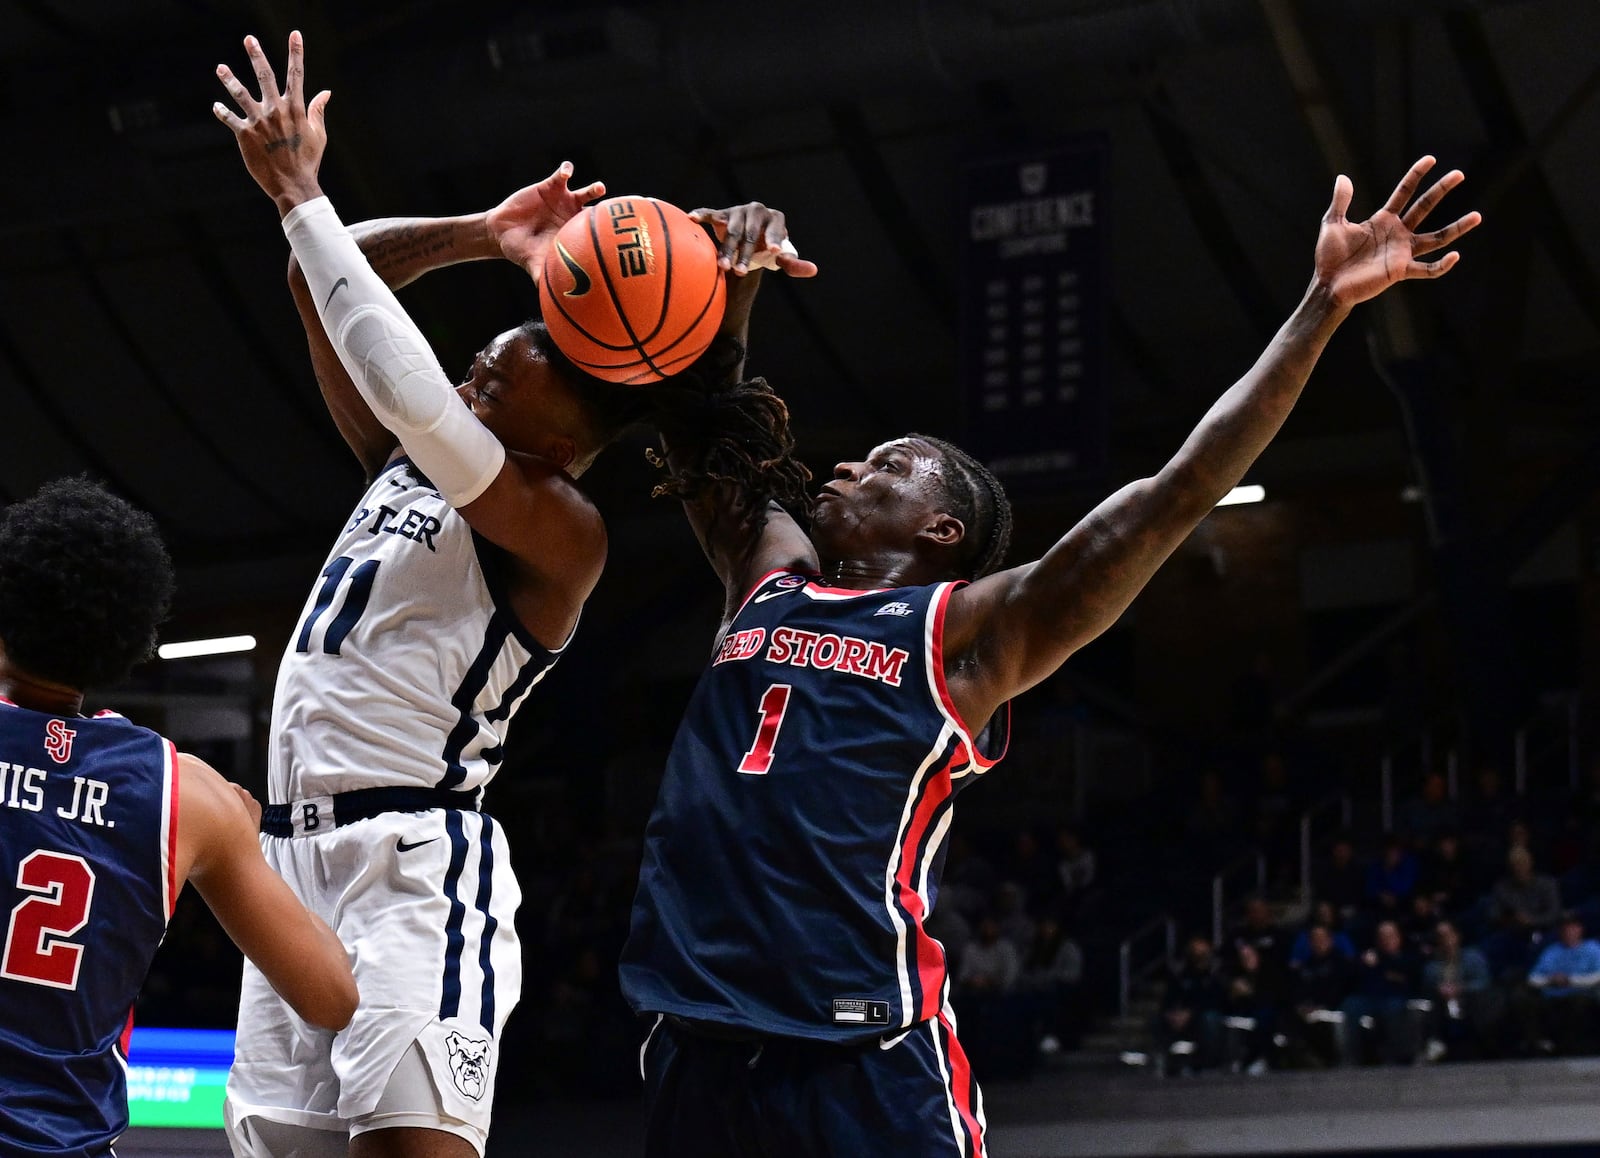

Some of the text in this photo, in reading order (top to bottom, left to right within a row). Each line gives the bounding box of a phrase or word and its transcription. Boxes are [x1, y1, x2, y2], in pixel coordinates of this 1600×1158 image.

[609, 201, 648, 279] ELITE
[971, 190, 1094, 241] CONFERENCE
[296, 556, 381, 656] 11
[712, 627, 909, 687] RED STORM
[737, 683, 792, 775] 1
[57, 776, 115, 828] JR.
[303, 804, 320, 831] B
[0, 849, 96, 991] 2
[873, 1006, 881, 1018] L
